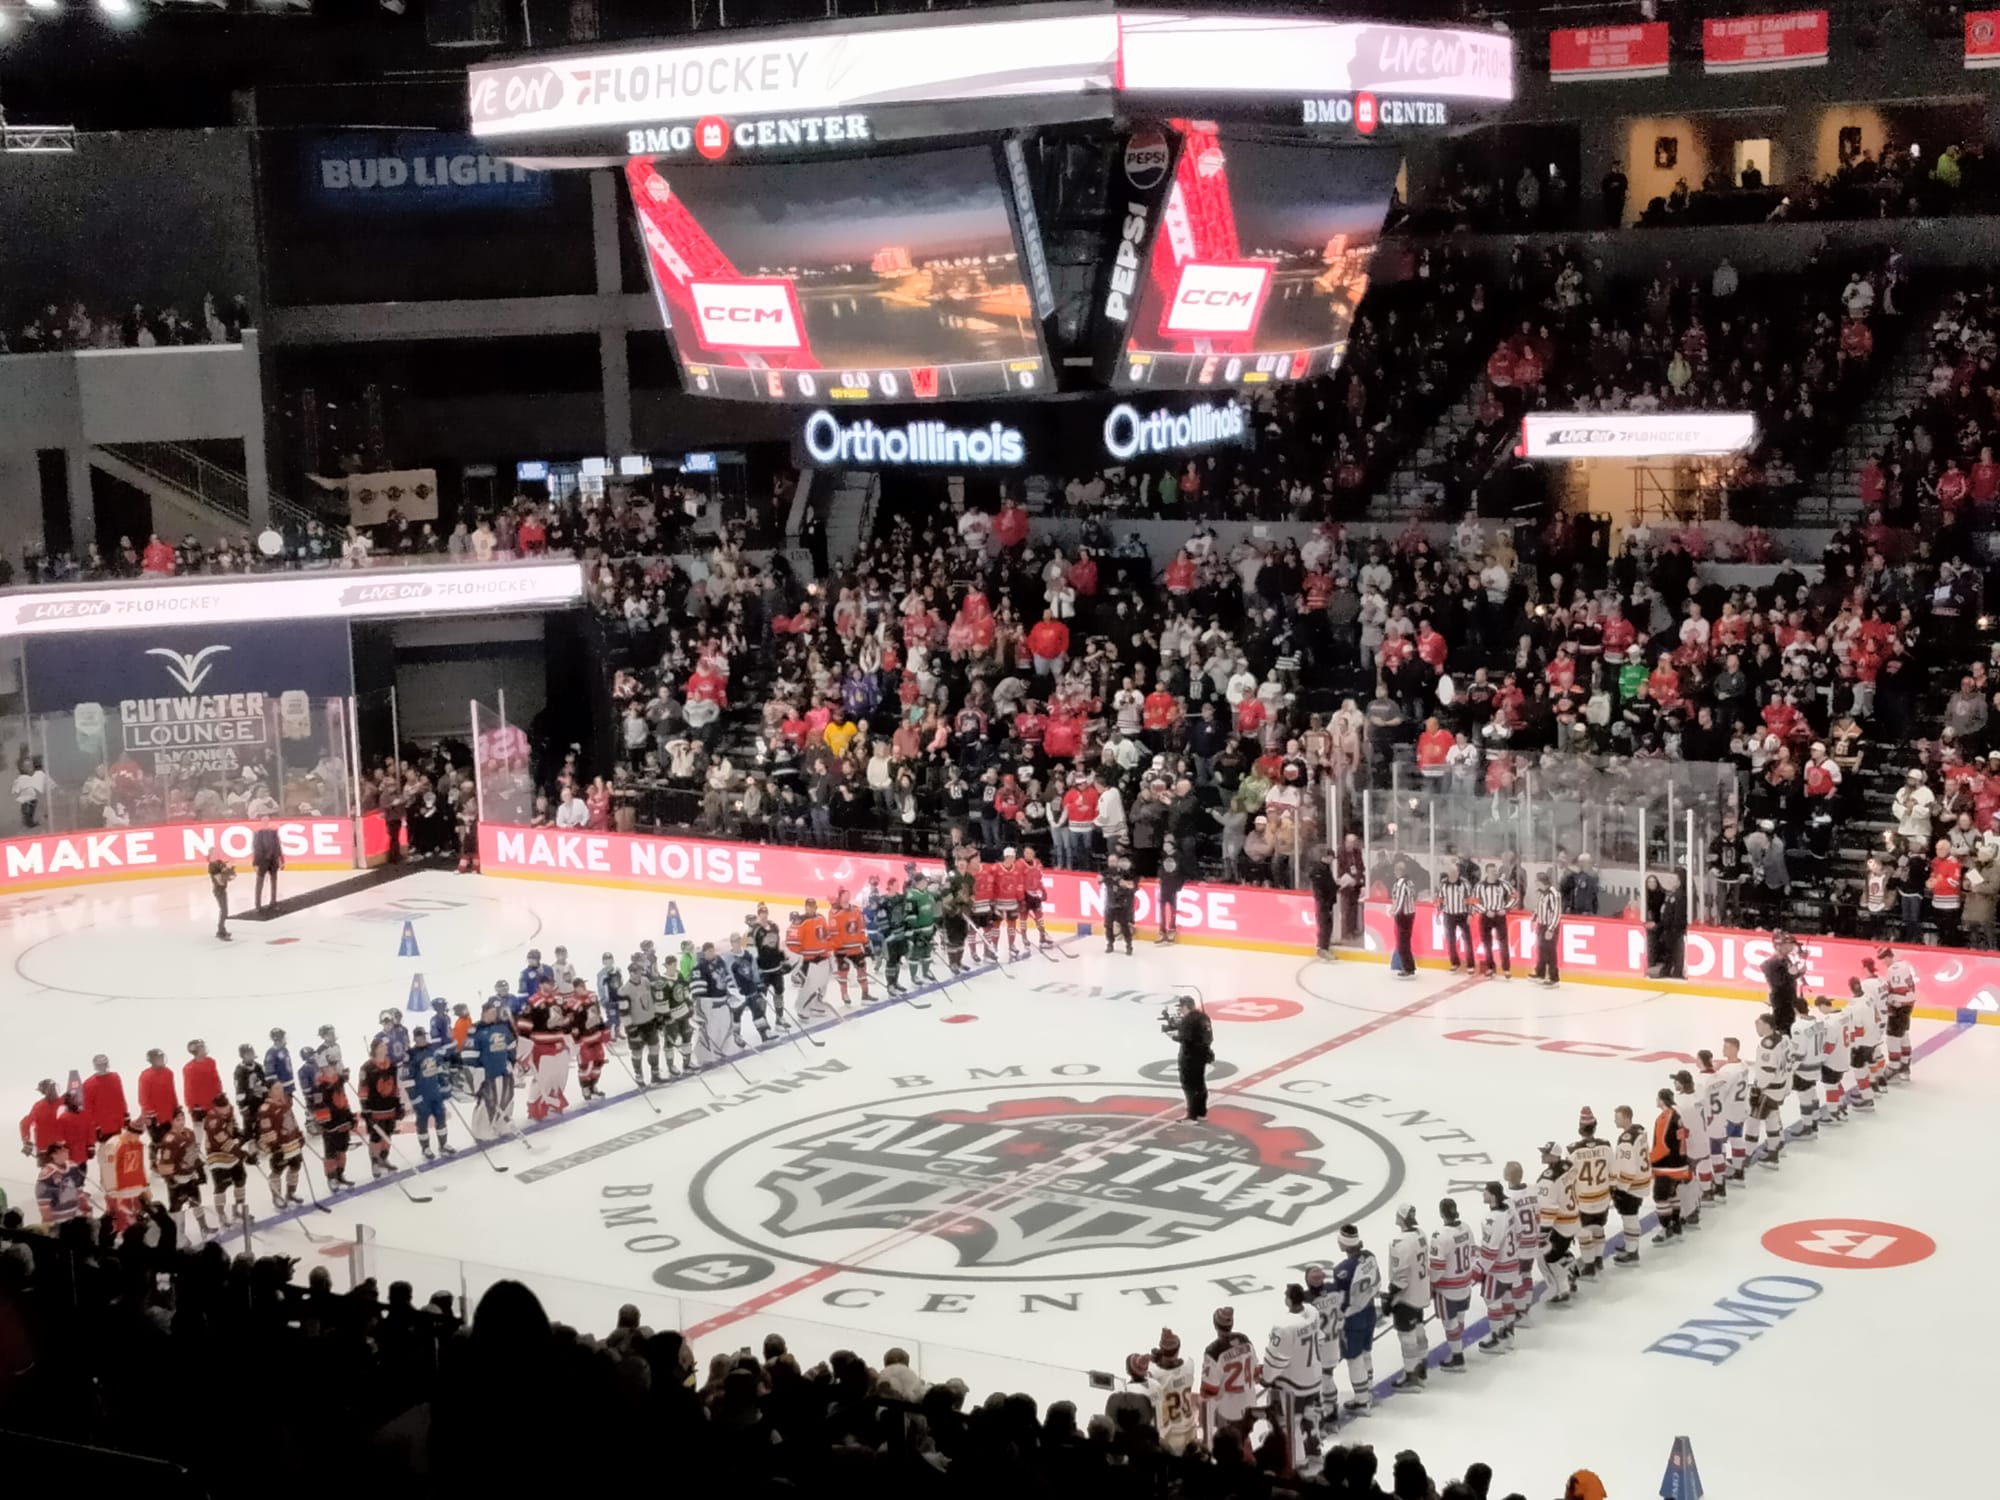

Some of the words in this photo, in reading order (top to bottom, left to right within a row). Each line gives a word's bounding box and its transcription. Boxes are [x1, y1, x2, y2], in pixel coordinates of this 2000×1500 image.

[1378, 35, 1427, 74] LIVE
[1431, 40, 1462, 76] ON
[504, 70, 554, 111] ON
[1303, 99, 1351, 123] BMO
[1379, 101, 1447, 125] CENTER
[626, 125, 693, 154] BMO
[733, 113, 870, 147] CENTER
[1126, 150, 1167, 165] PEPSI
[320, 157, 409, 188] BUD
[1105, 201, 1148, 321] PEPSI
[1180, 289, 1253, 307] CCM
[703, 306, 783, 323] CCM
[797, 371, 816, 397] 0
[878, 370, 899, 397] 0
[359, 584, 398, 600] LIVE
[400, 583, 426, 598] ON
[446, 578, 537, 595] FLOHOCKEY
[34, 603, 74, 618] LIVE
[77, 601, 105, 616] ON
[125, 595, 221, 613] FLOHOCKEY
[119, 691, 265, 723] CUTWATER
[133, 720, 255, 746] LOUNGE
[6, 831, 157, 878] MAKE
[181, 822, 342, 861] NOSE
[496, 830, 611, 873] MAKE
[630, 841, 763, 886] NOISE
[890, 1063, 1102, 1090] BMO
[1709, 1092, 1723, 1116] 5
[787, 1117, 1024, 1165] ALL
[1177, 1140, 1250, 1161] AHL
[1578, 1159, 1607, 1187] 42
[600, 1183, 681, 1253] BMO
[1453, 1244, 1471, 1275] 18
[1642, 1275, 1824, 1367] BMO
